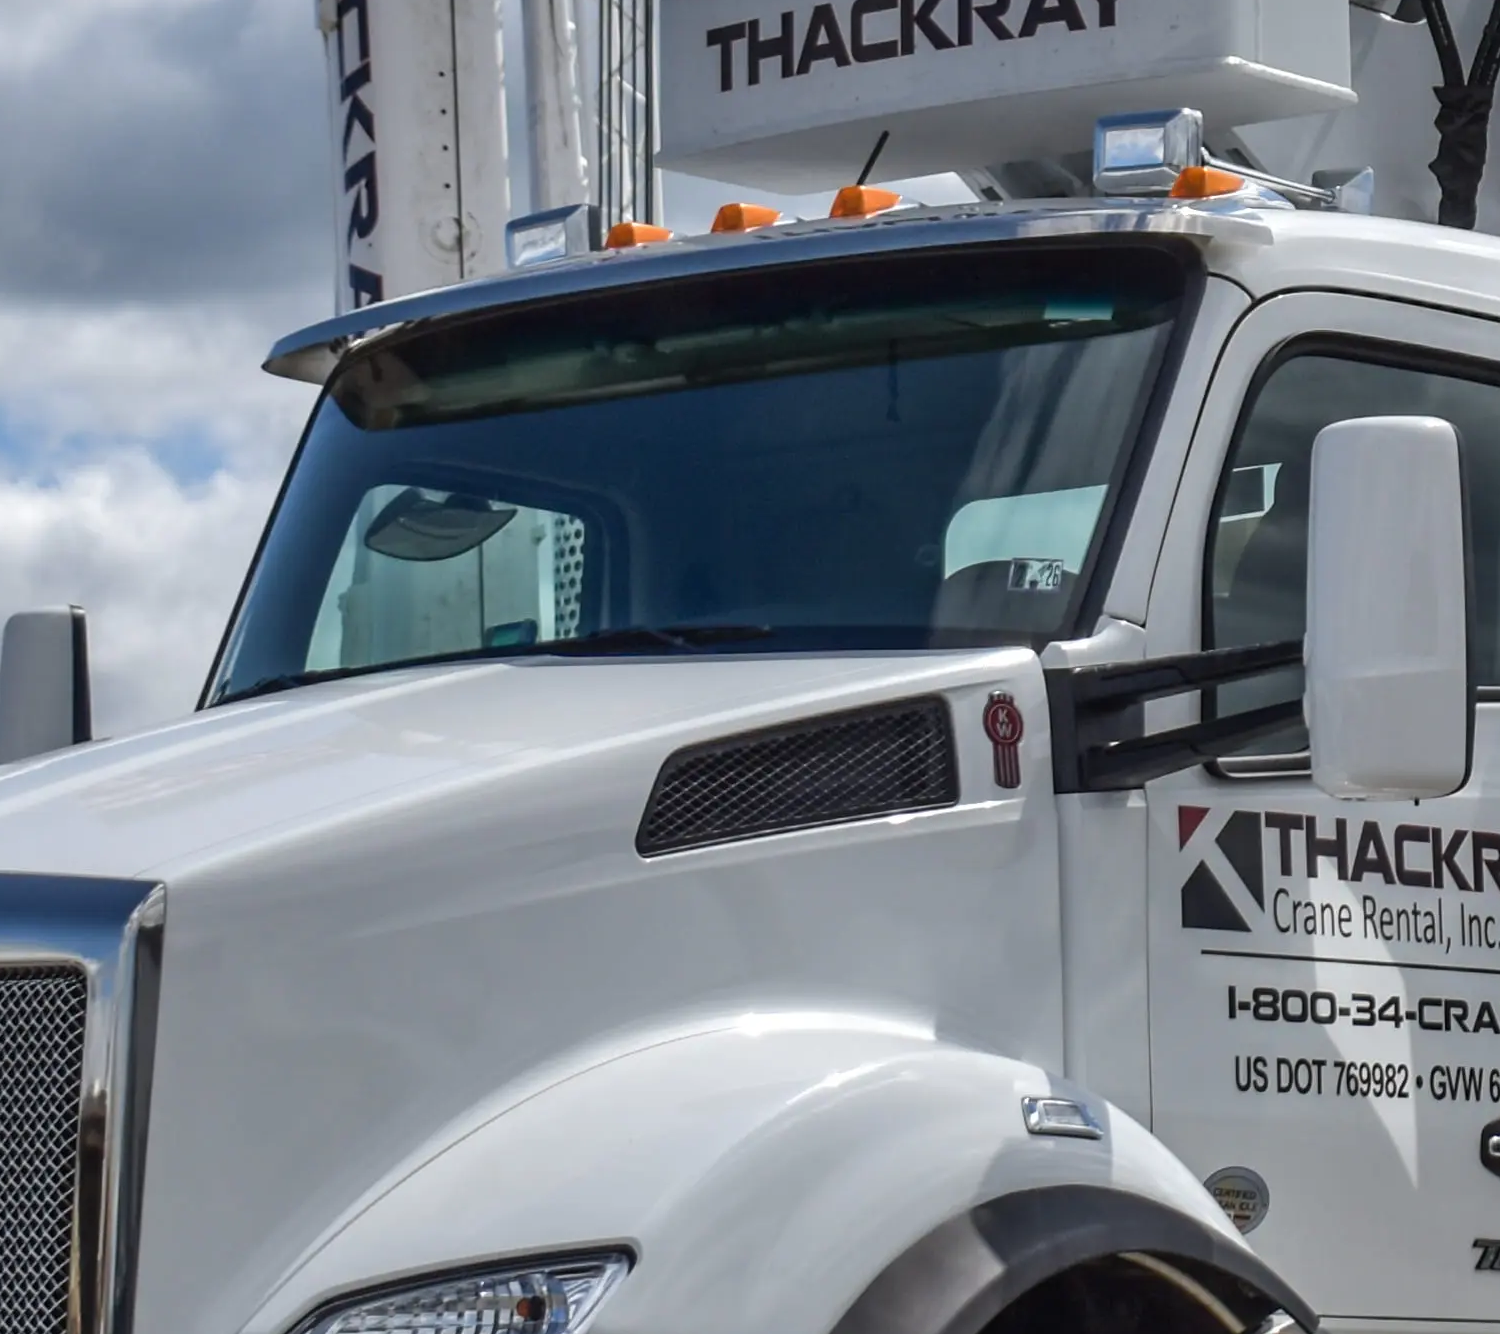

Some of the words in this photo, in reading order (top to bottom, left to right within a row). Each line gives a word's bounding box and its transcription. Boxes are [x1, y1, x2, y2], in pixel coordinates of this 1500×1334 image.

[1273, 887, 1353, 938] Crane
[1361, 895, 1452, 954] Rental,
[1235, 1055, 1269, 1093] US
[1276, 1057, 1328, 1095] DOT
[1334, 1060, 1410, 1099] 769982
[1429, 1066, 1484, 1103] GVW
